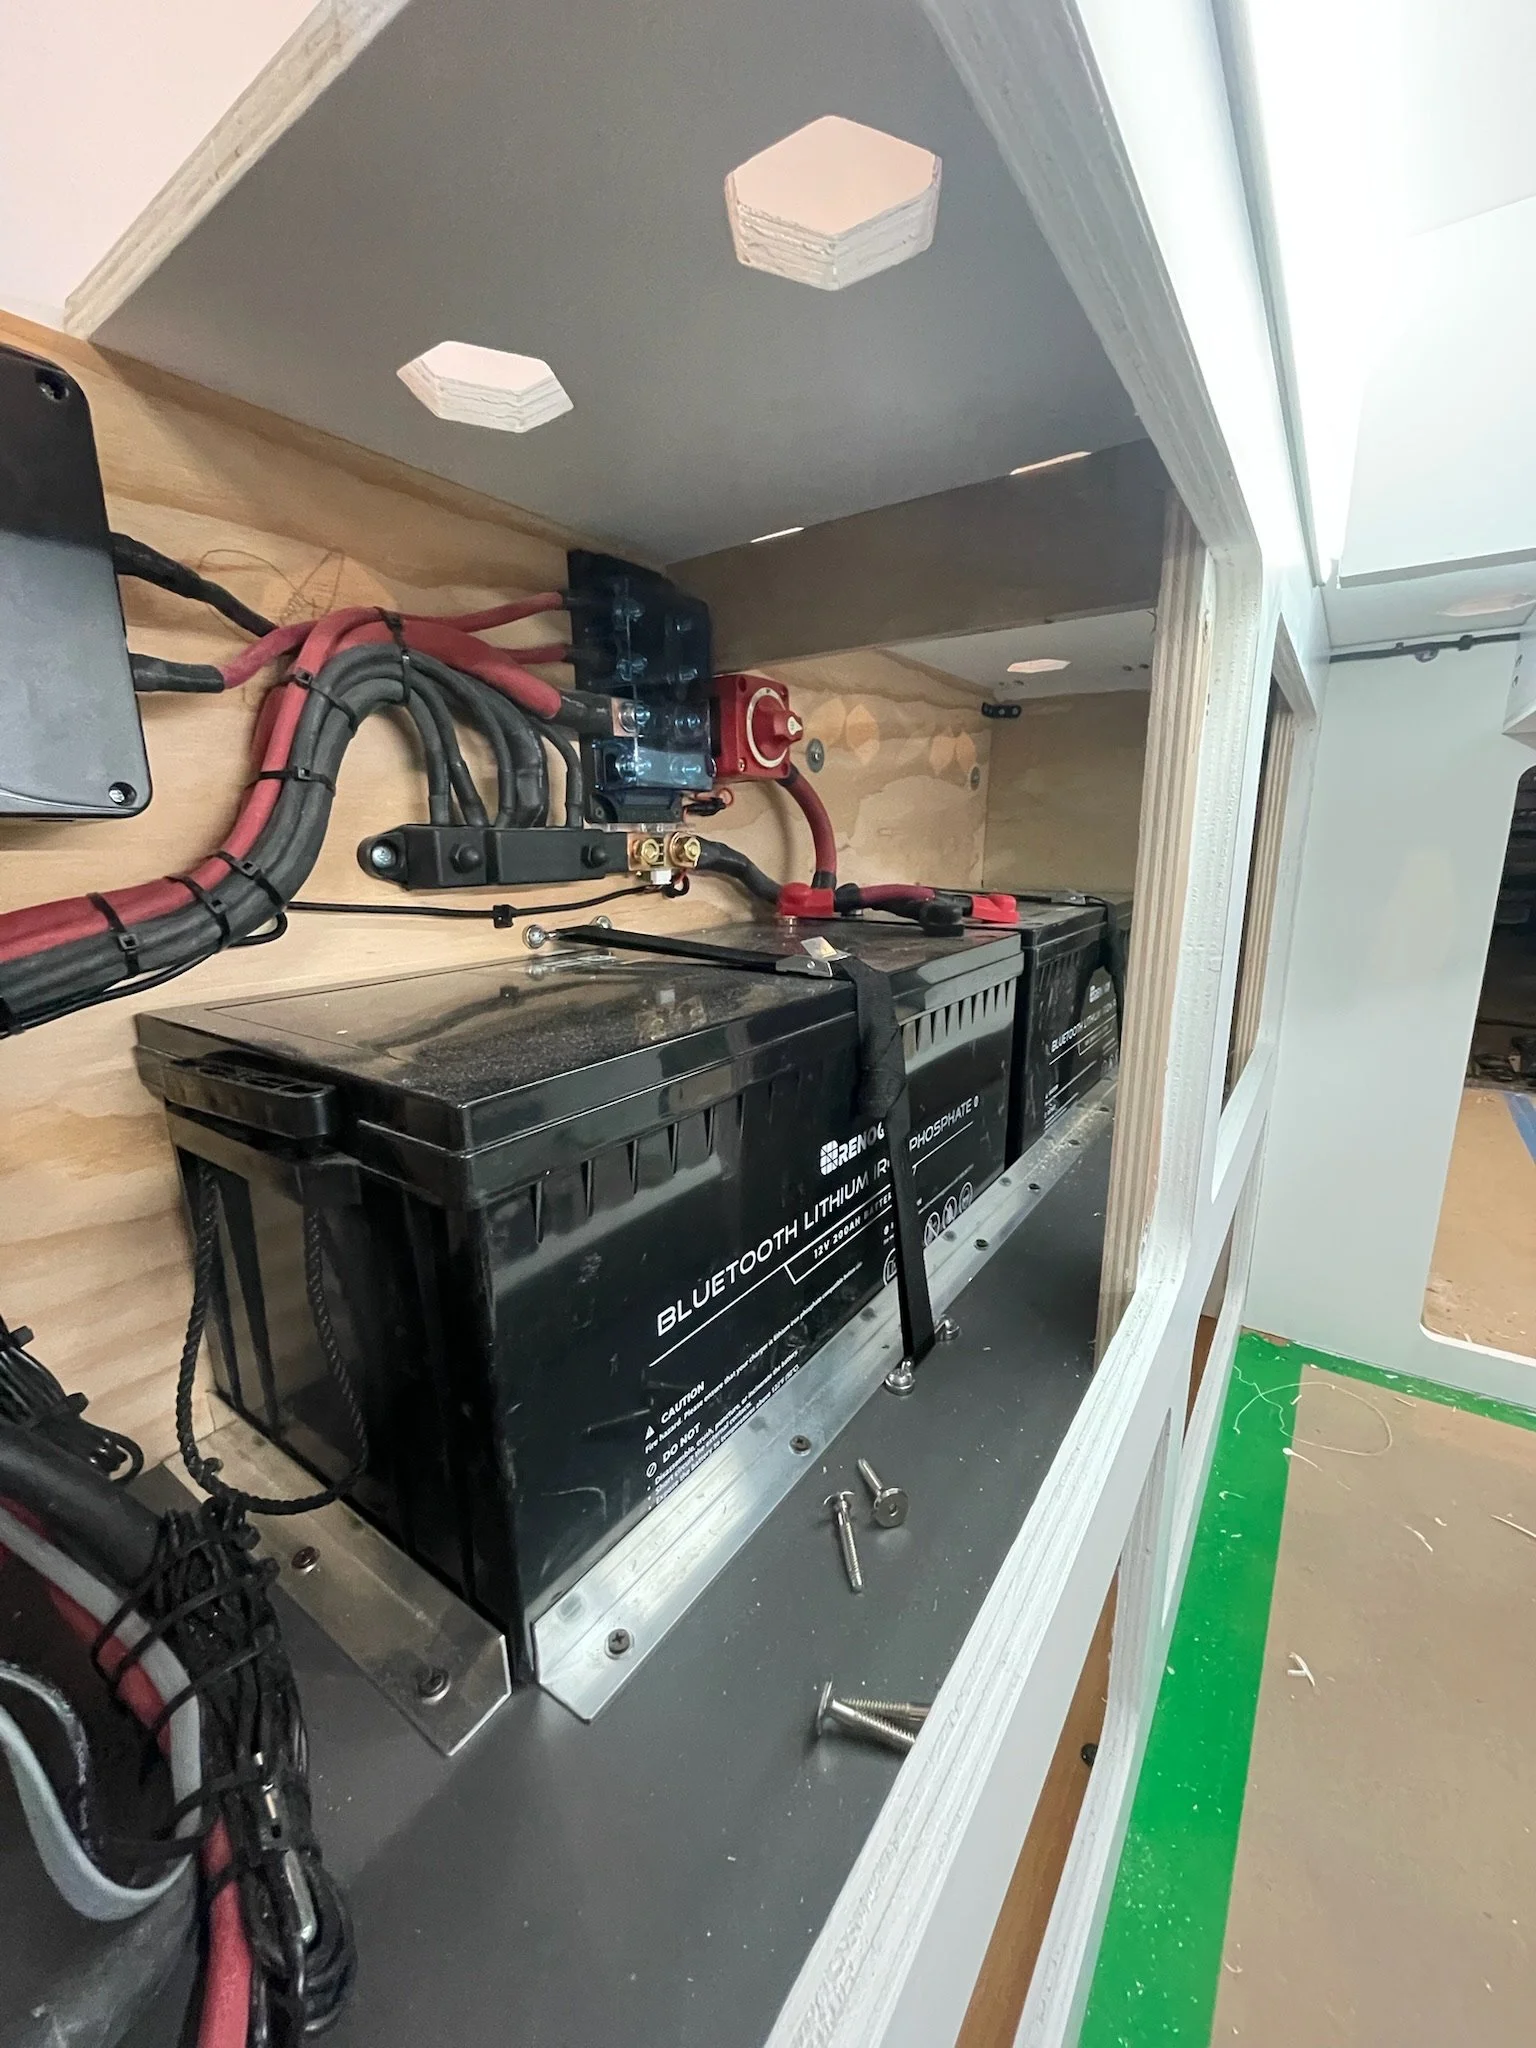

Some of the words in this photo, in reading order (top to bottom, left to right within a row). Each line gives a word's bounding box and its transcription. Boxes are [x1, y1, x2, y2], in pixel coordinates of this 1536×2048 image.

[838, 1121, 885, 1167] RENOG
[657, 1219, 798, 1337] BLUETOOTH
[804, 1171, 869, 1231] LITHIUM
[873, 1157, 890, 1181] IR
[909, 1097, 973, 1152] PHOSPHATE
[813, 1239, 830, 1259] 12V
[863, 1191, 892, 1220] BATTER
[661, 1380, 705, 1424] CAUTION
[645, 1439, 659, 1454] Fire
[662, 1443, 679, 1464] DO
[679, 1421, 701, 1448] NOT
